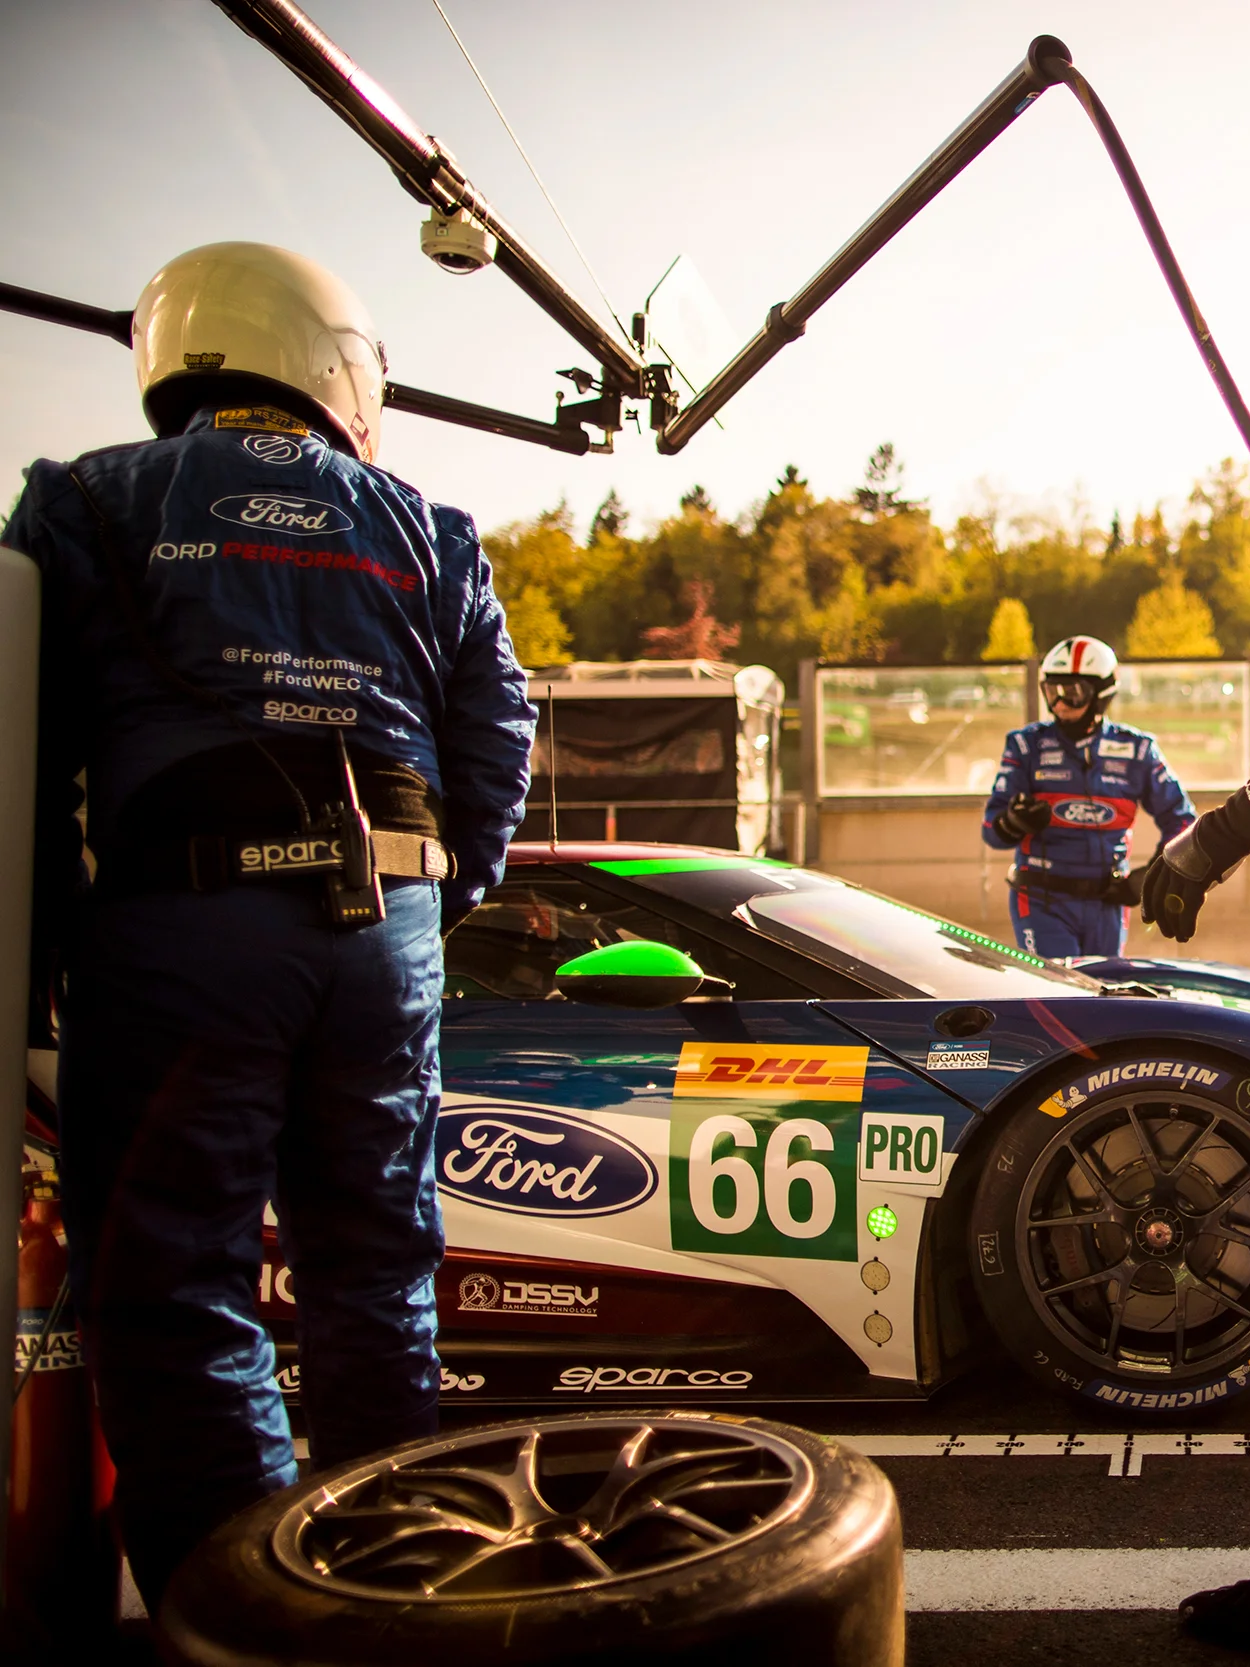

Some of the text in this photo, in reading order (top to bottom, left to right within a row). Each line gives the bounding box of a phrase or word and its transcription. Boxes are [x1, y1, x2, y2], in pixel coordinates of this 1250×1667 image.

[241, 498, 327, 530] Ford
[222, 541, 418, 592] PERFORMANCE
[222, 648, 382, 676] @FordPerformance
[263, 670, 361, 690] #FordWEC
[263, 700, 357, 726] sparco
[1064, 803, 1106, 823] Ford
[928, 1061, 987, 1069] RACING
[940, 1052, 988, 1062] GANASSI
[704, 1057, 832, 1085] DHL
[1087, 1062, 1219, 1093] MICHELIN
[443, 1119, 603, 1202] Ford
[865, 1124, 938, 1173] PRO
[688, 1115, 836, 1239] 66
[503, 1281, 599, 1307] DSSV
[542, 1306, 598, 1314] TECHNOLOGY
[553, 1366, 753, 1393] sparco
[1053, 1367, 1085, 1391] FORD
[1095, 1380, 1228, 1409] MICHELIN
